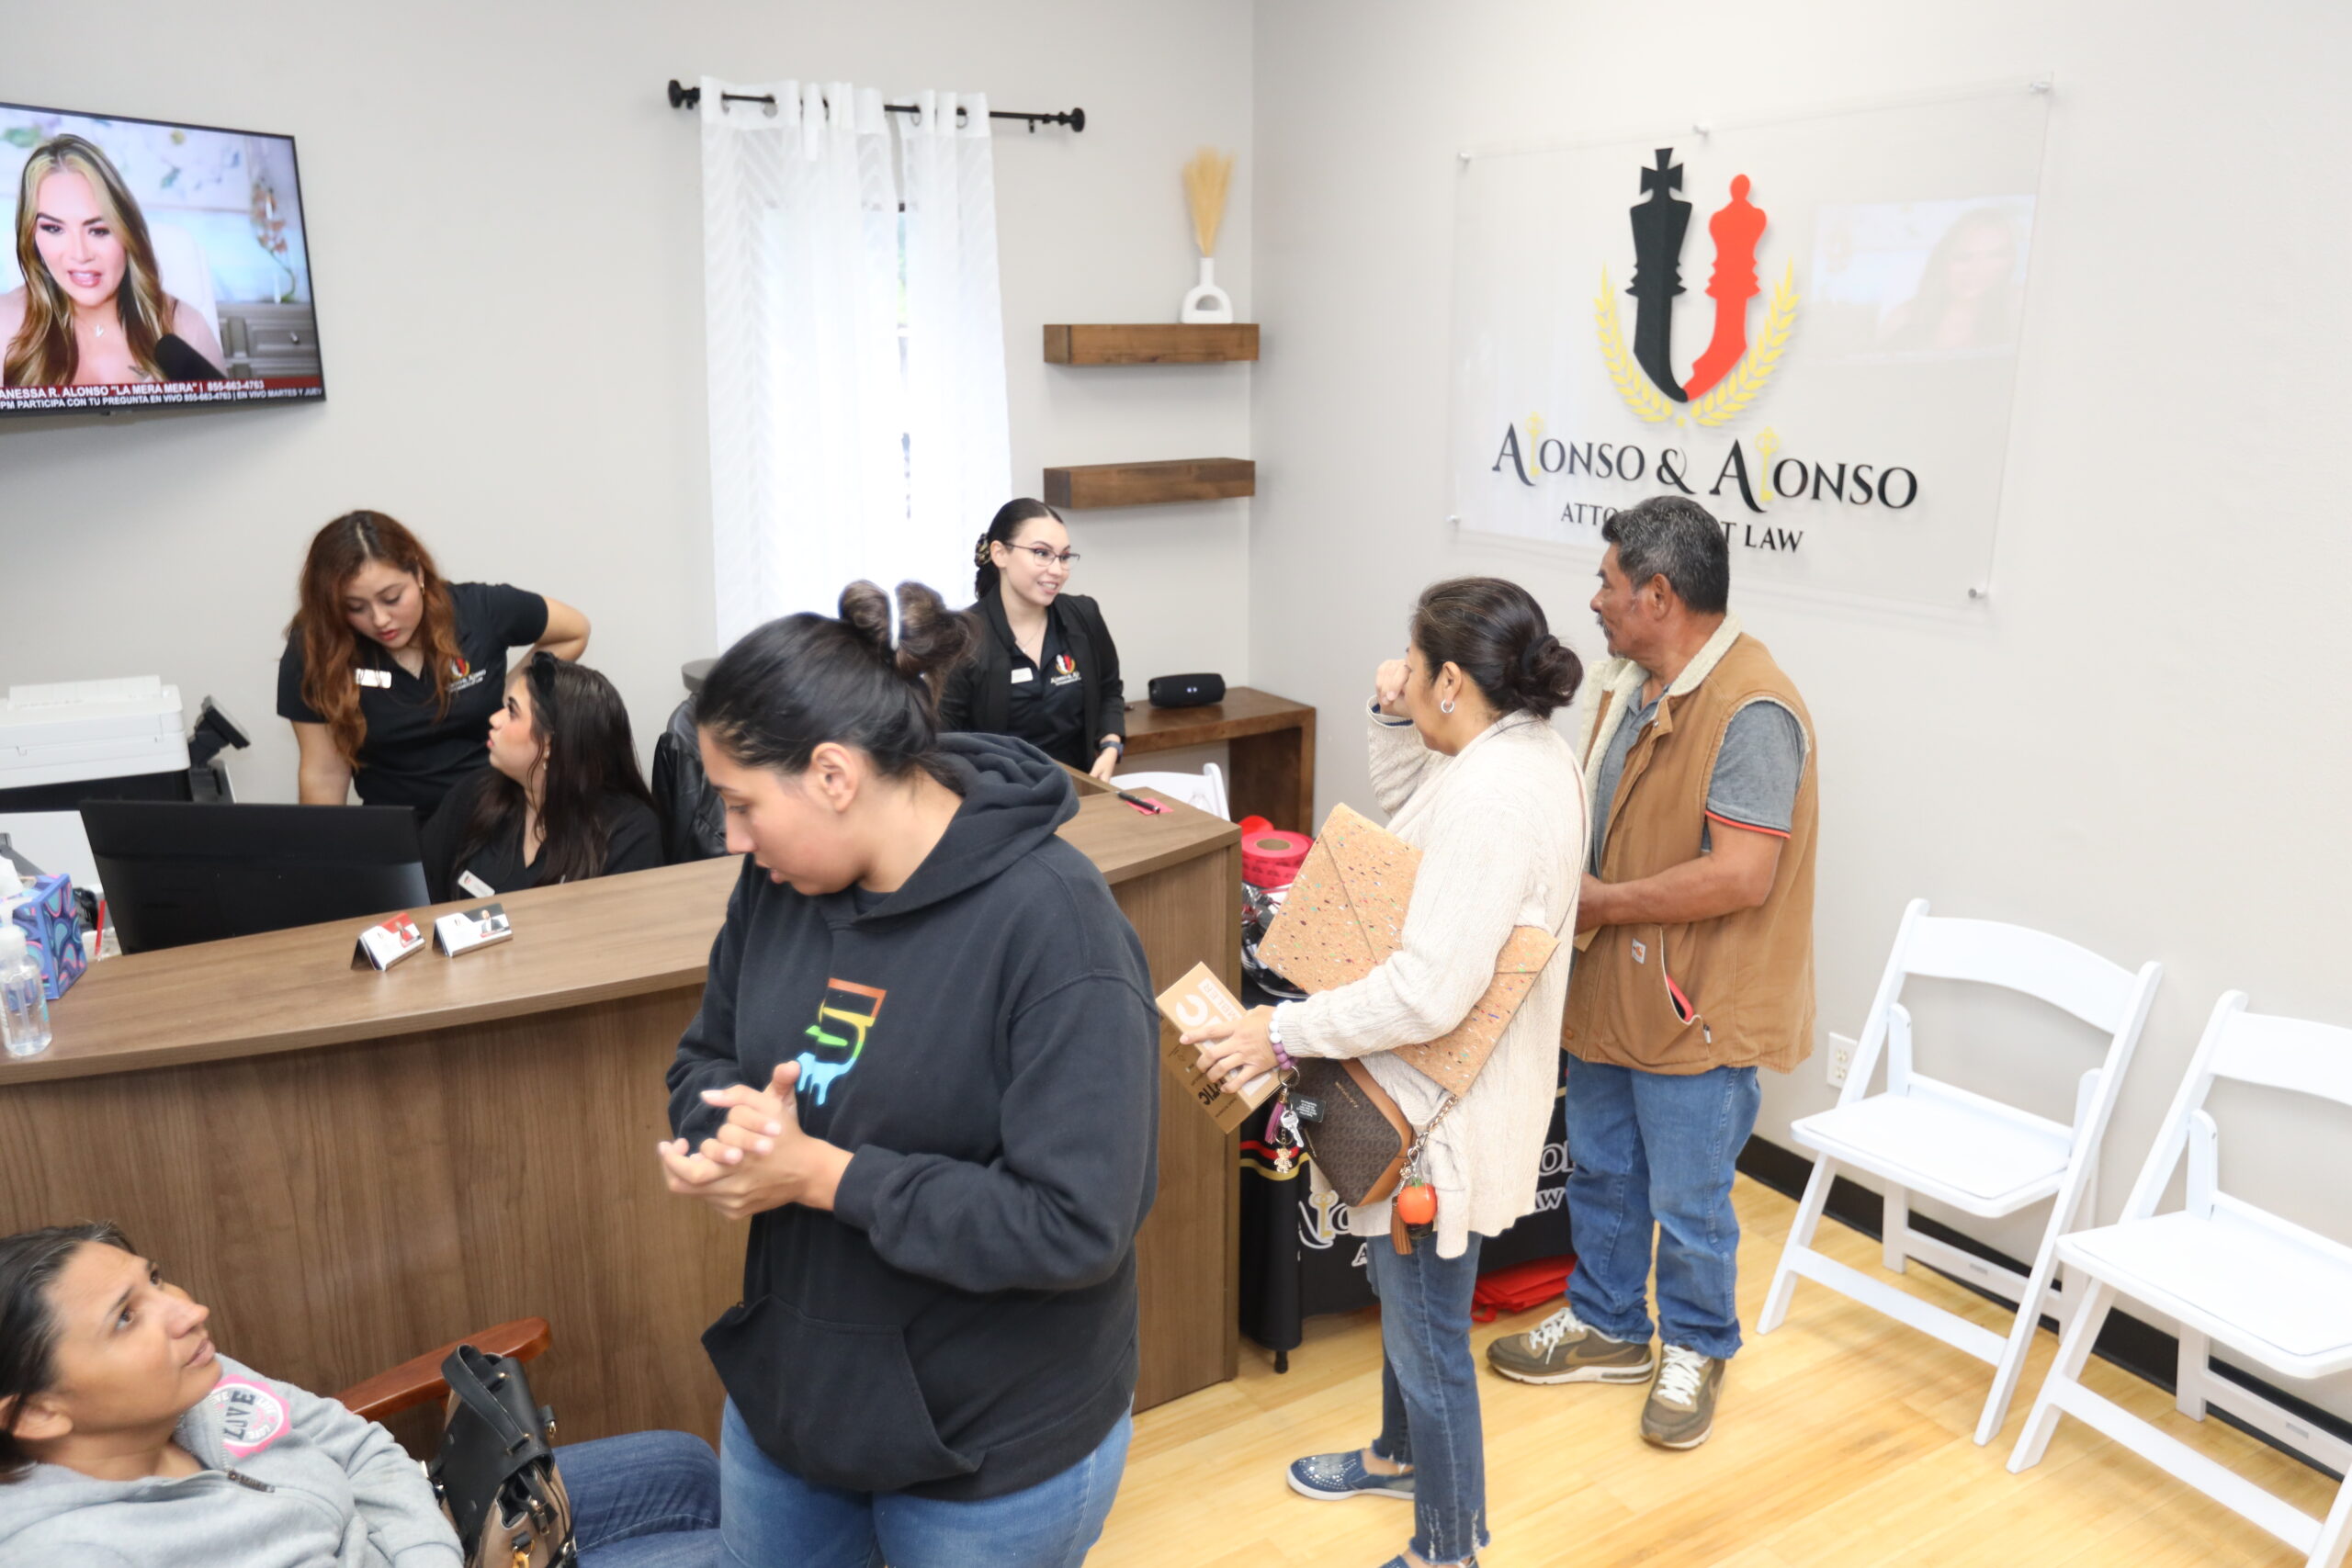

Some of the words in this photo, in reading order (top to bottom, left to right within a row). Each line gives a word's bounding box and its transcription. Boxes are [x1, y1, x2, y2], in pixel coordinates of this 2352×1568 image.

[0, 400, 16, 410] PM
[17, 397, 66, 409] PARTICIPA
[67, 396, 87, 407] CON
[89, 395, 101, 406] TU
[102, 393, 150, 406] PREGUNTA
[151, 393, 162, 403] EN
[164, 391, 183, 402] VIVO
[237, 389, 248, 400] EN
[248, 388, 266, 399] VIVO
[267, 387, 297, 398] MARTES
[49, 387, 61, 398] R.
[62, 385, 109, 398] ALONSO
[132, 383, 163, 395] MERA
[1656, 446, 1697, 495] &
[1745, 524, 1804, 553] LAW
[1203, 982, 1240, 1021] MBLER
